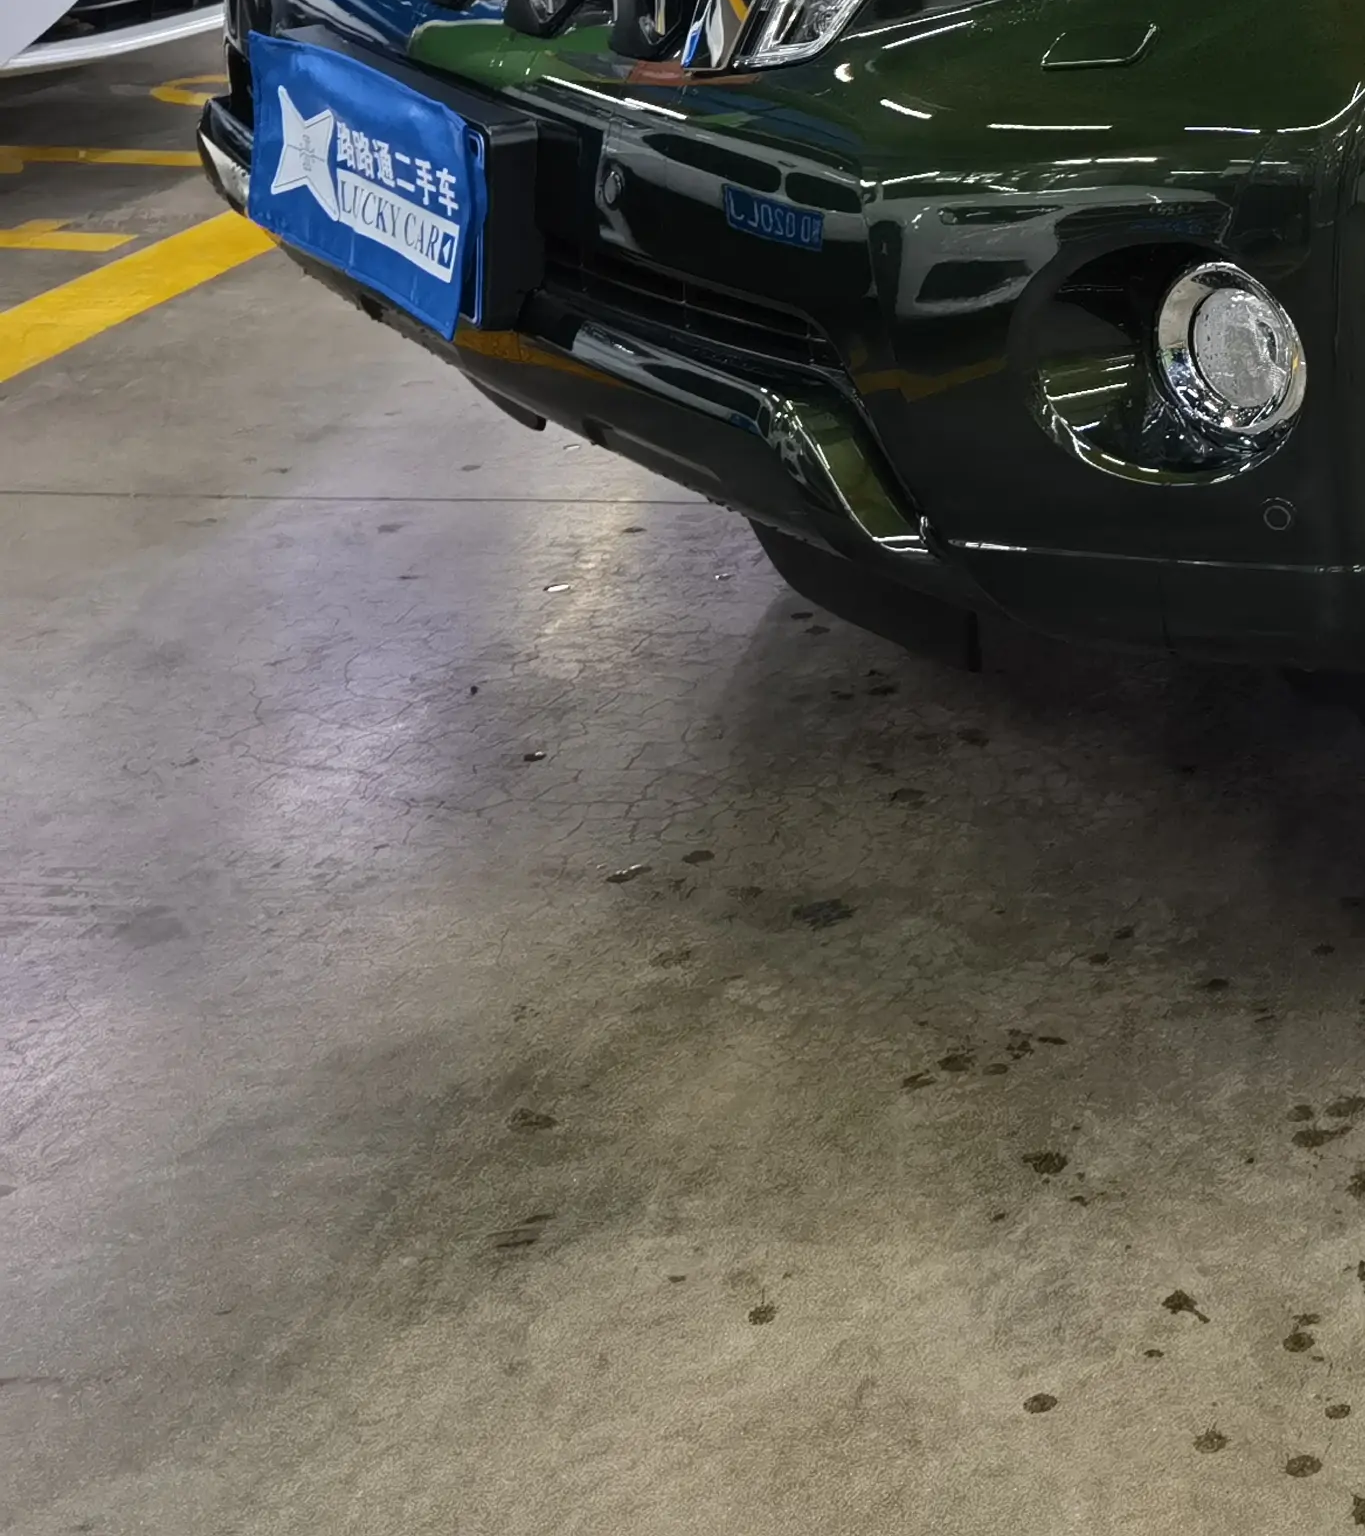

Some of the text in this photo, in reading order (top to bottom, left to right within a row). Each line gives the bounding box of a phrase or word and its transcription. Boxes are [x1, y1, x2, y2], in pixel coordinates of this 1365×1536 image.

[336, 121, 460, 217] 路路通二手车
[340, 180, 440, 261] LUCKY CAR
